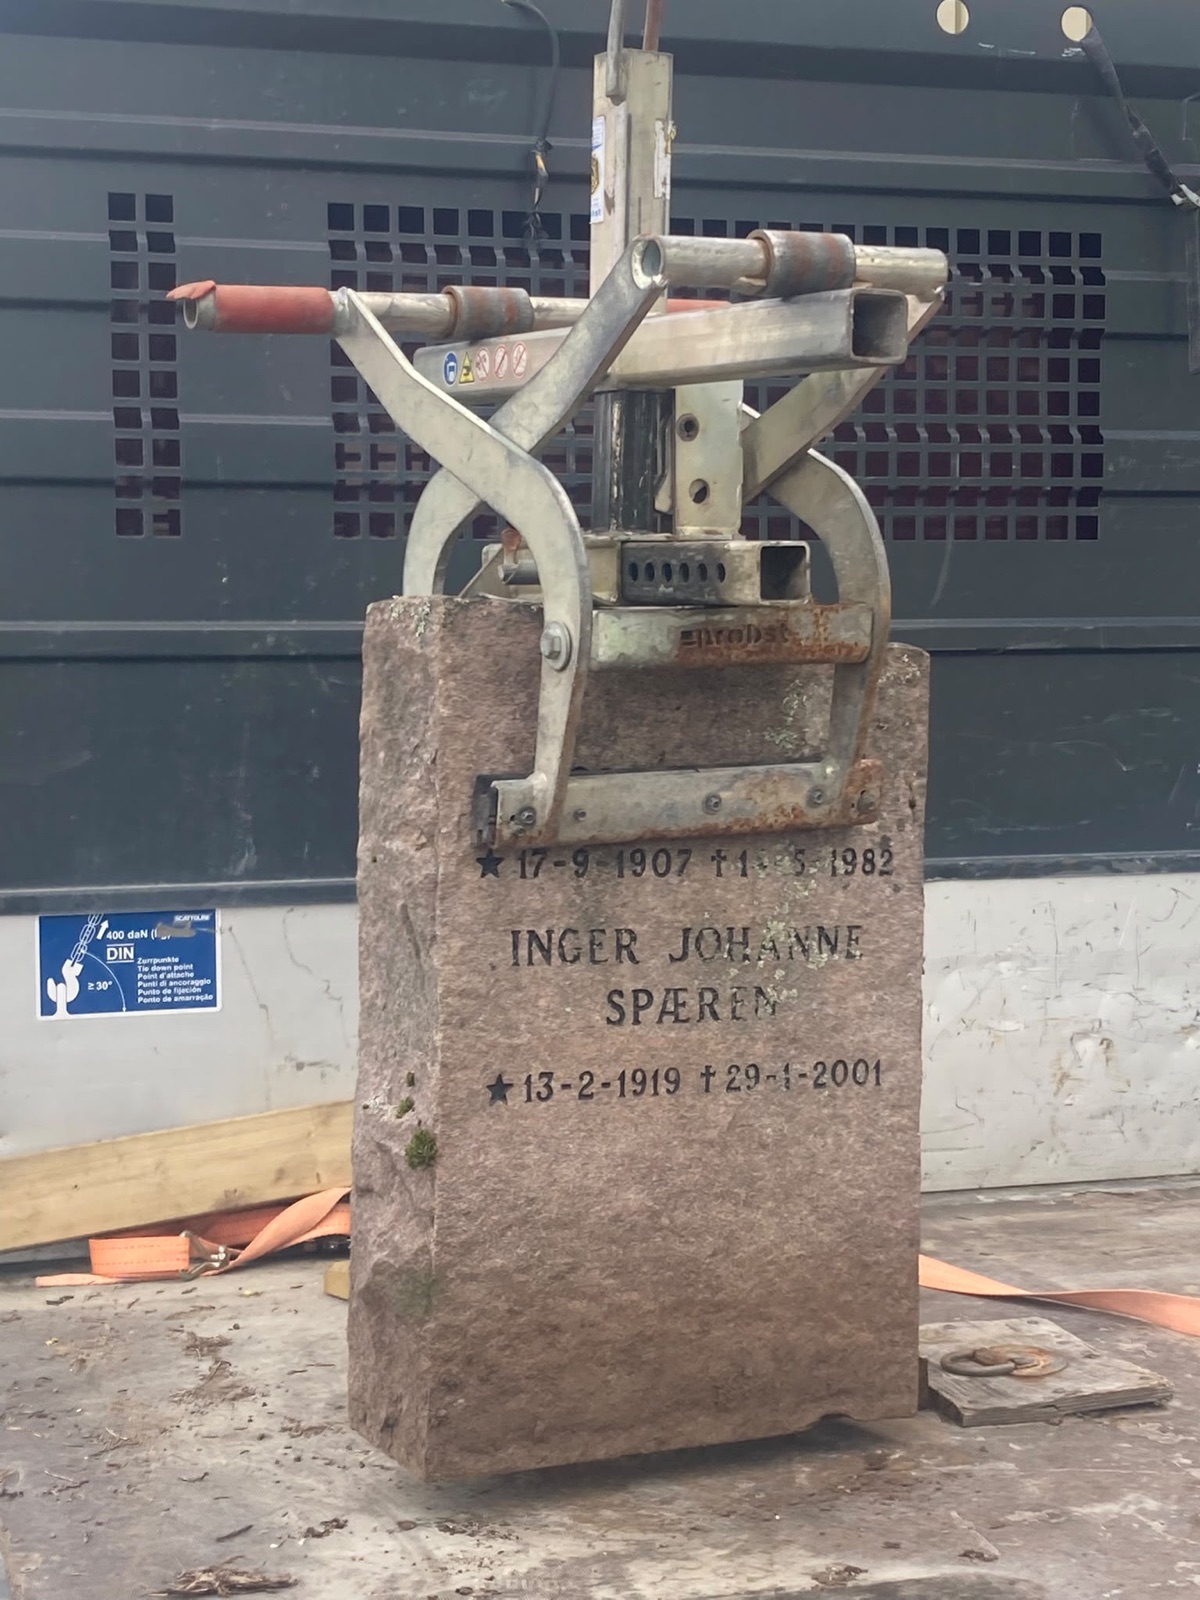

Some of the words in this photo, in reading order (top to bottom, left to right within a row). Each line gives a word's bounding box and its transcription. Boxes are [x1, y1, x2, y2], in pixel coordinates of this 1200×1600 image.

[106, 930, 125, 940] 400
[128, 929, 148, 940] daN
[510, 927, 641, 966] INGER
[668, 924, 864, 963] JOHANNE
[106, 946, 135, 961] DIN
[137, 956, 180, 965] Zurrpunkte
[151, 964, 172, 972] down
[174, 963, 194, 972] point
[159, 971, 195, 979] d'attache
[137, 980, 158, 988] Punti
[169, 978, 212, 987] ancoraggio
[138, 988, 161, 996] Punto
[138, 996, 161, 1004] Ponto
[162, 995, 172, 1003] de
[605, 985, 778, 1026] SPÆREN
[523, 1066, 682, 1103] 13-2-1919
[725, 1058, 882, 1093] 29-1-2001
